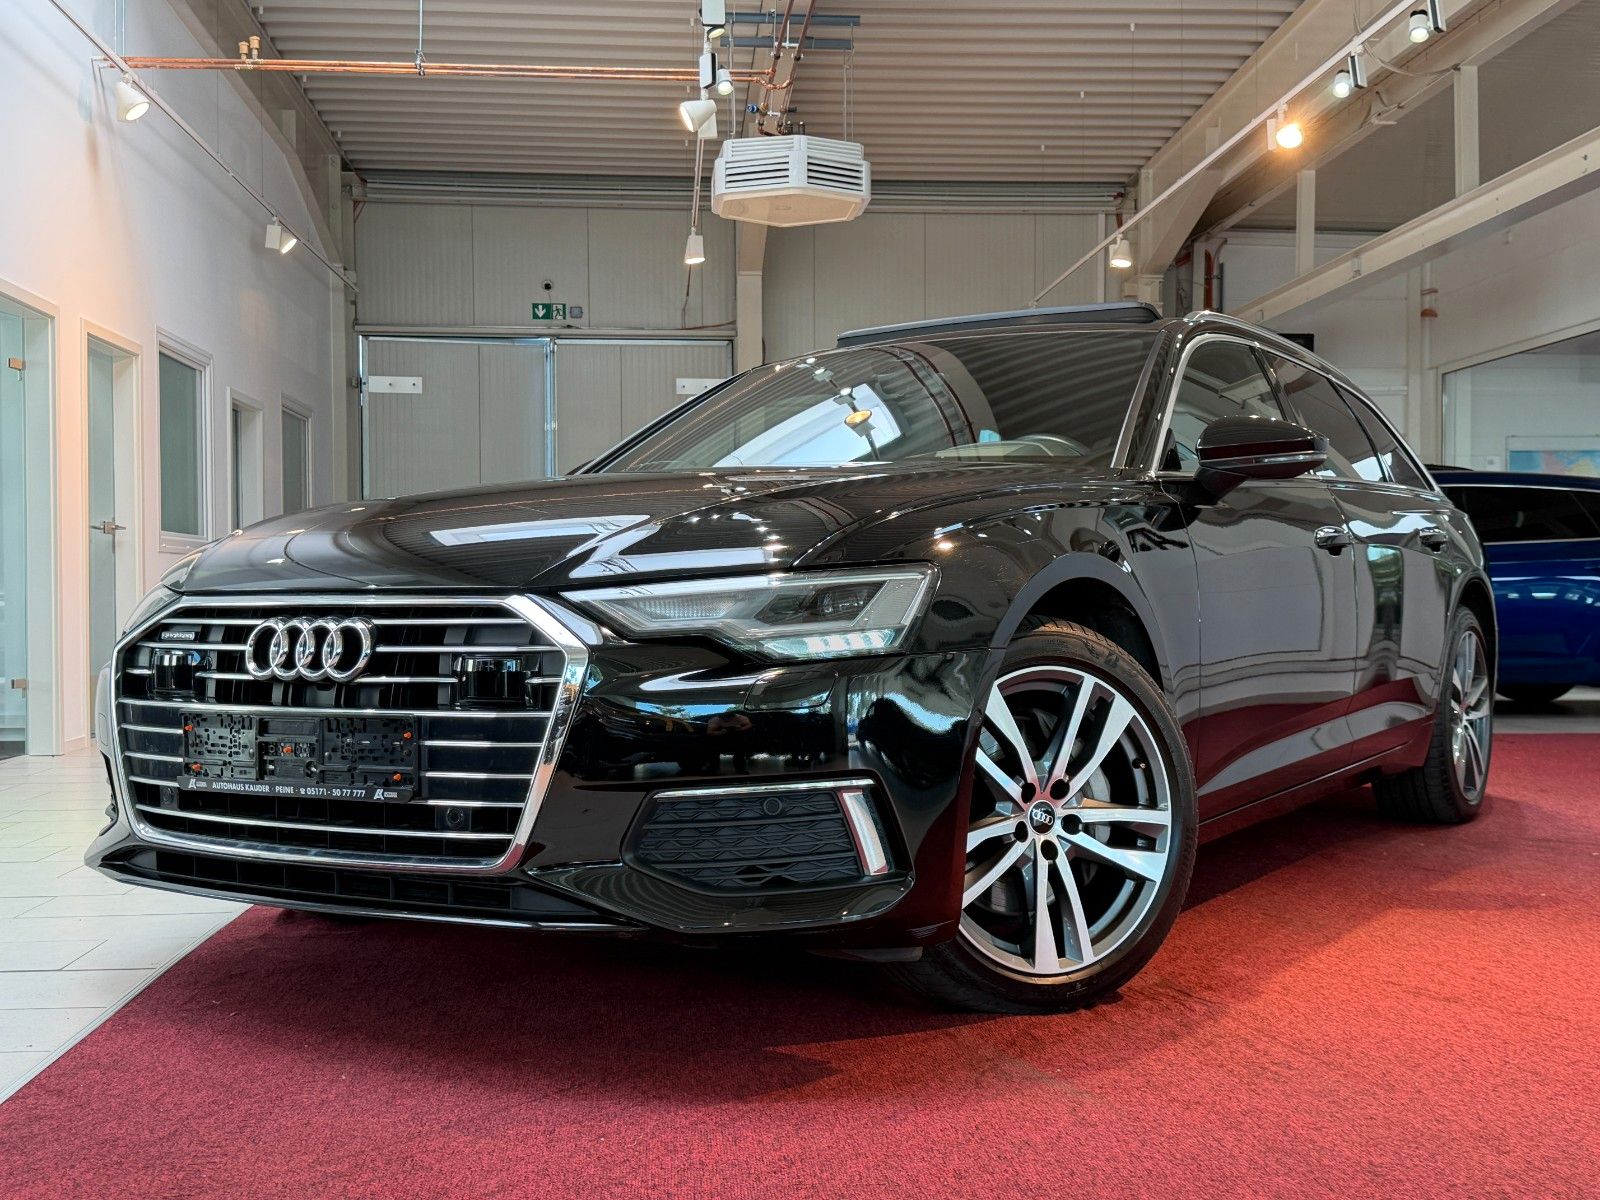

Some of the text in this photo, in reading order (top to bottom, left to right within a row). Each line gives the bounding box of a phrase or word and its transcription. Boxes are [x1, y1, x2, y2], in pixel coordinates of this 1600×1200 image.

[212, 781, 244, 791] AUTOHAUS
[245, 783, 270, 792] KAUDER
[275, 785, 294, 794] PEINE
[306, 787, 327, 795] 05171
[332, 788, 341, 796] 50
[352, 789, 366, 797] 777
